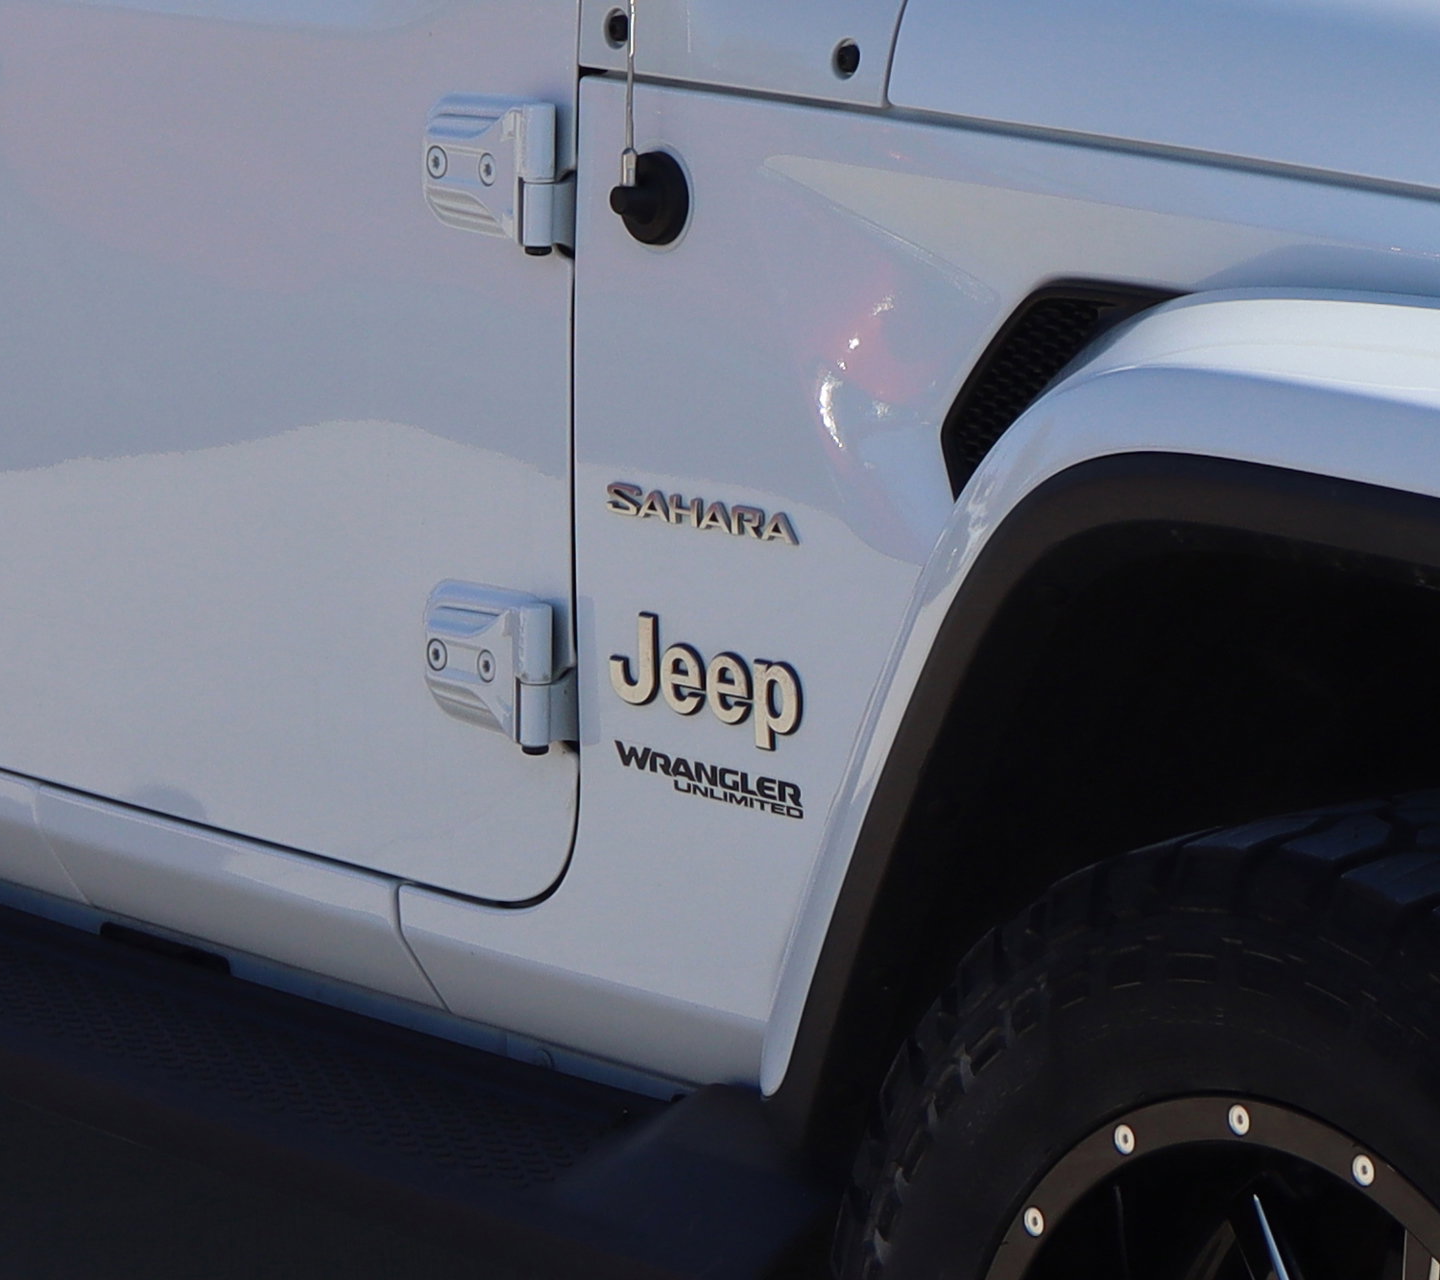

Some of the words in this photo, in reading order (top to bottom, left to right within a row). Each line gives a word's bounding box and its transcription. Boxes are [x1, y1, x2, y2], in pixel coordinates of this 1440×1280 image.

[606, 481, 800, 546] SAHARA
[609, 611, 803, 752] Jeep
[614, 739, 803, 807] WRANGLER
[673, 779, 804, 820] UNLIMITED
